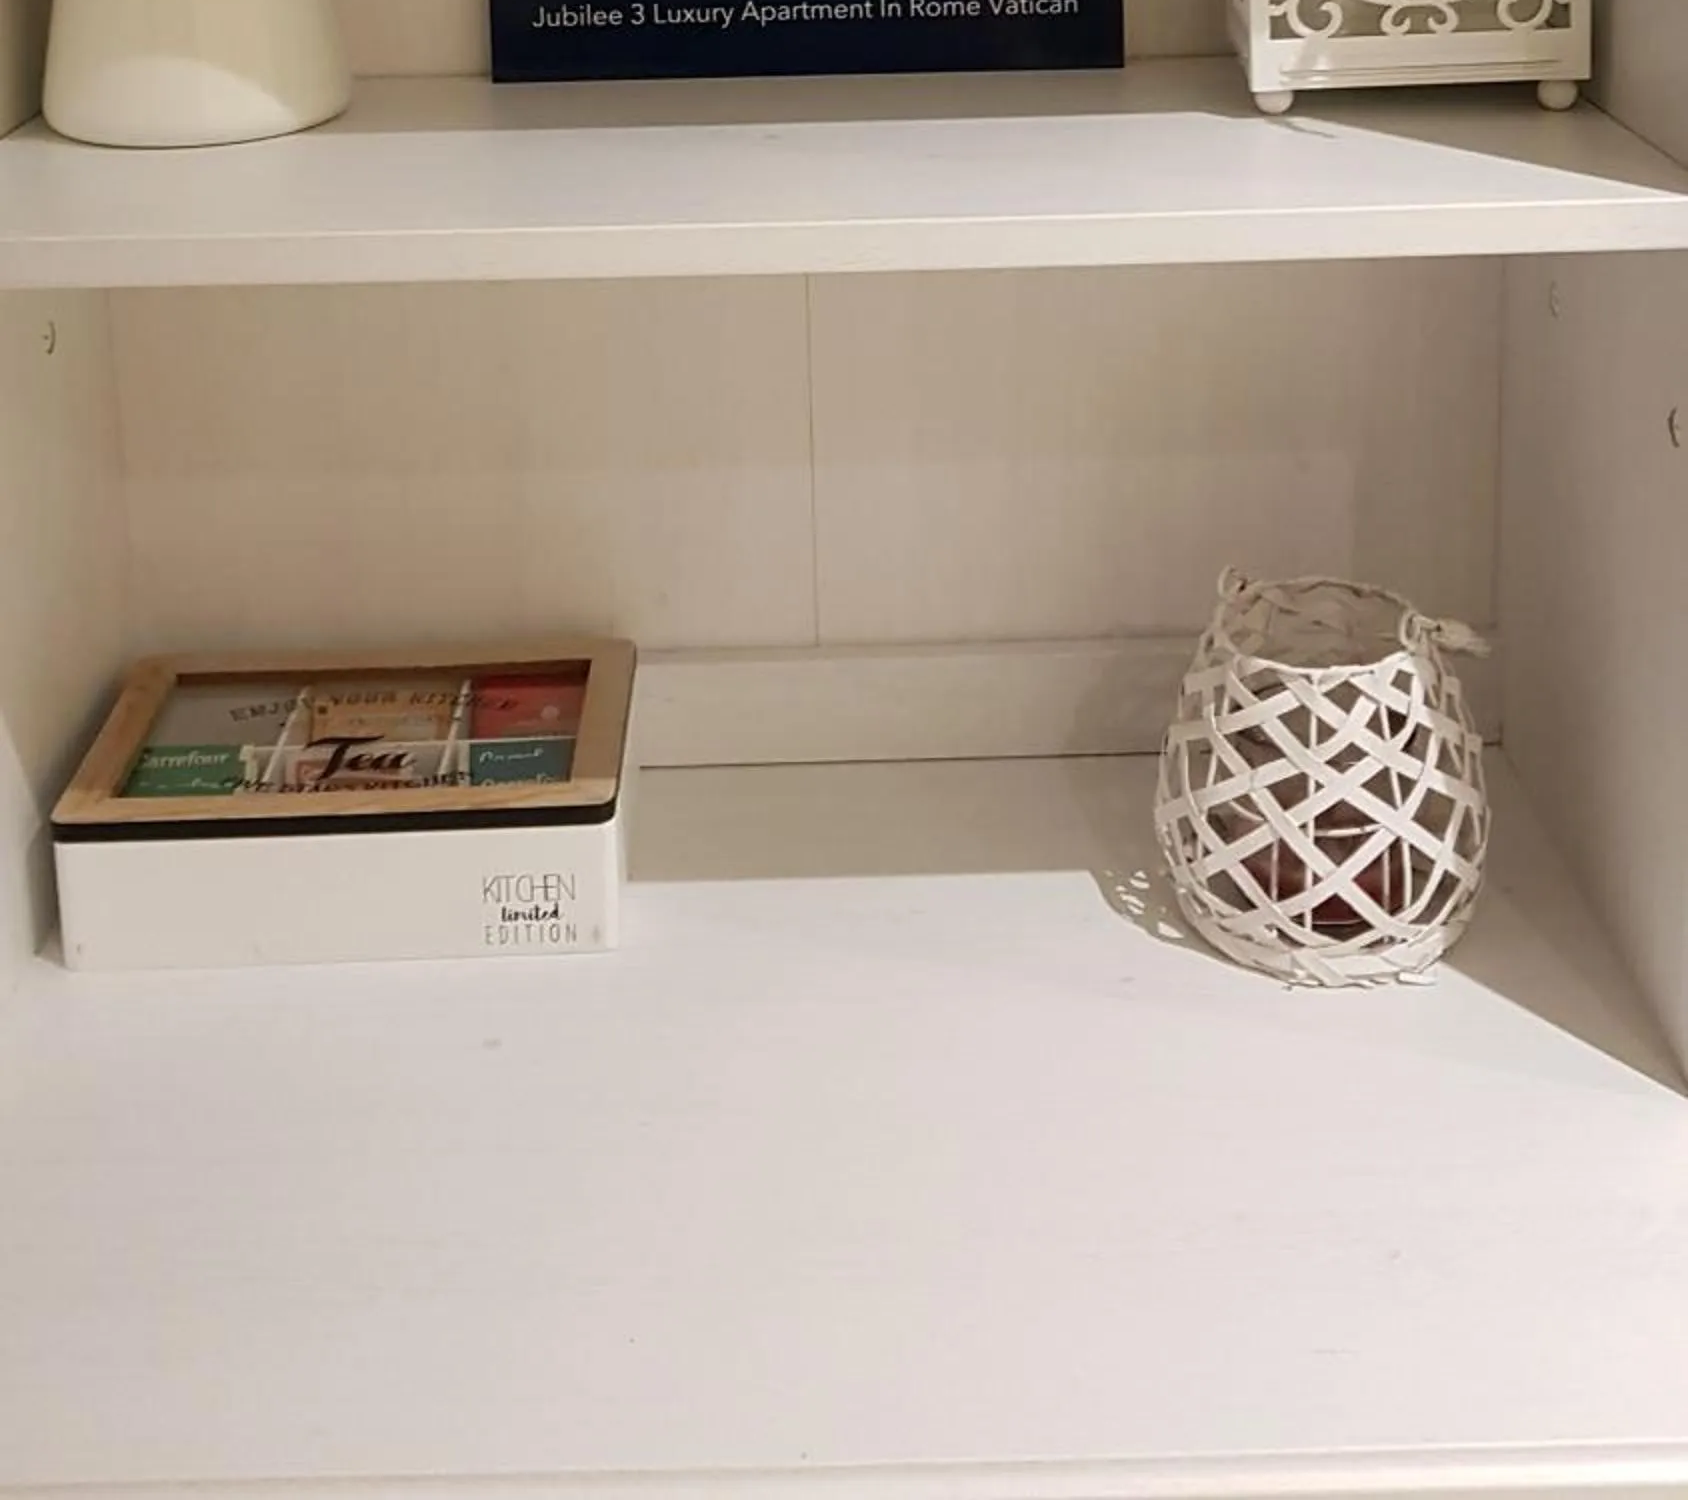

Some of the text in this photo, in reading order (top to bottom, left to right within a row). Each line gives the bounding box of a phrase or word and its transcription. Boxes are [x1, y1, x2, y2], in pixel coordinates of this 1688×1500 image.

[531, 3, 624, 28] Jubilee
[630, 3, 646, 25] 3
[652, 3, 735, 29] Luxury
[740, 0, 874, 27] Apartment
[304, 734, 418, 782] Tea
[482, 872, 577, 903] KITCHEN
[501, 900, 566, 923] limited
[483, 922, 578, 945] EDITION
